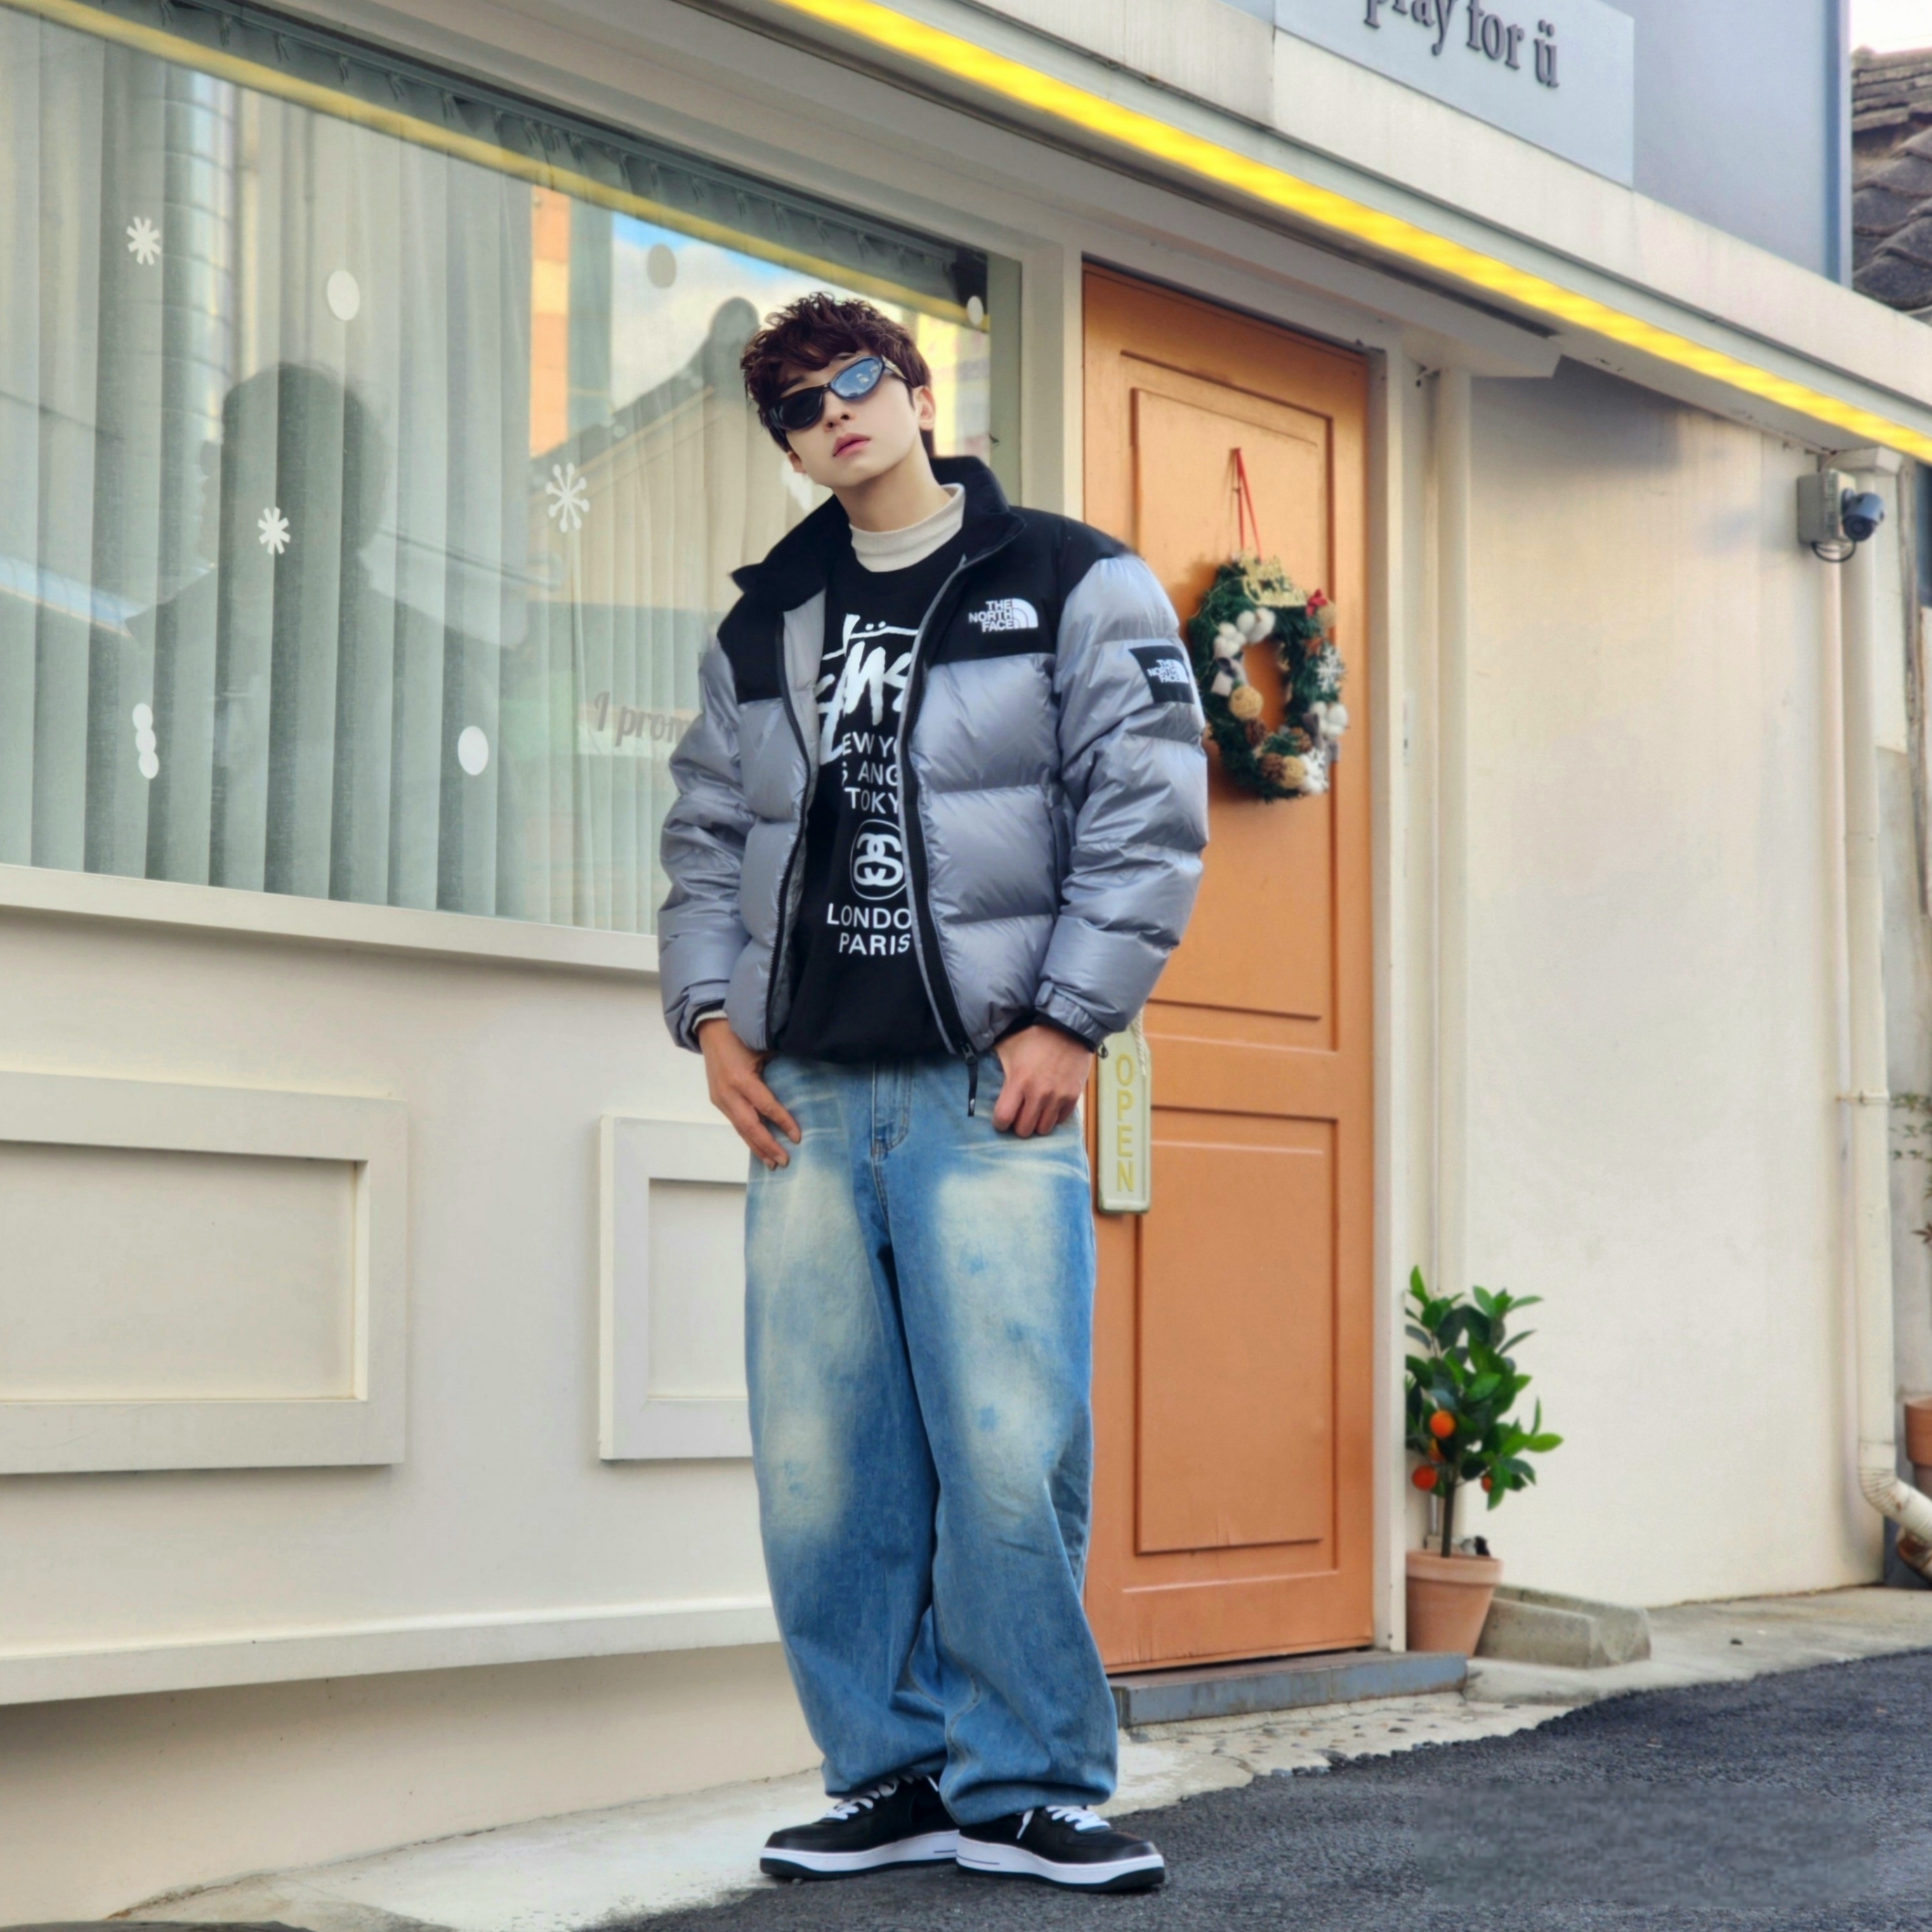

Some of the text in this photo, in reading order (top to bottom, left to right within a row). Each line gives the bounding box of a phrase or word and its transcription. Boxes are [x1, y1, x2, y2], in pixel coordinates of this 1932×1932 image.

[1466, 0, 1525, 70] for
[1533, 19, 1559, 88] ü
[985, 598, 1011, 611] THE
[968, 609, 1012, 624] NORTH
[982, 619, 1014, 632] FACE
[1147, 666, 1178, 677] NORTH
[1159, 673, 1181, 683] FACE
[839, 932, 912, 956] PARIS
[1116, 1053, 1135, 1192] OPEN
